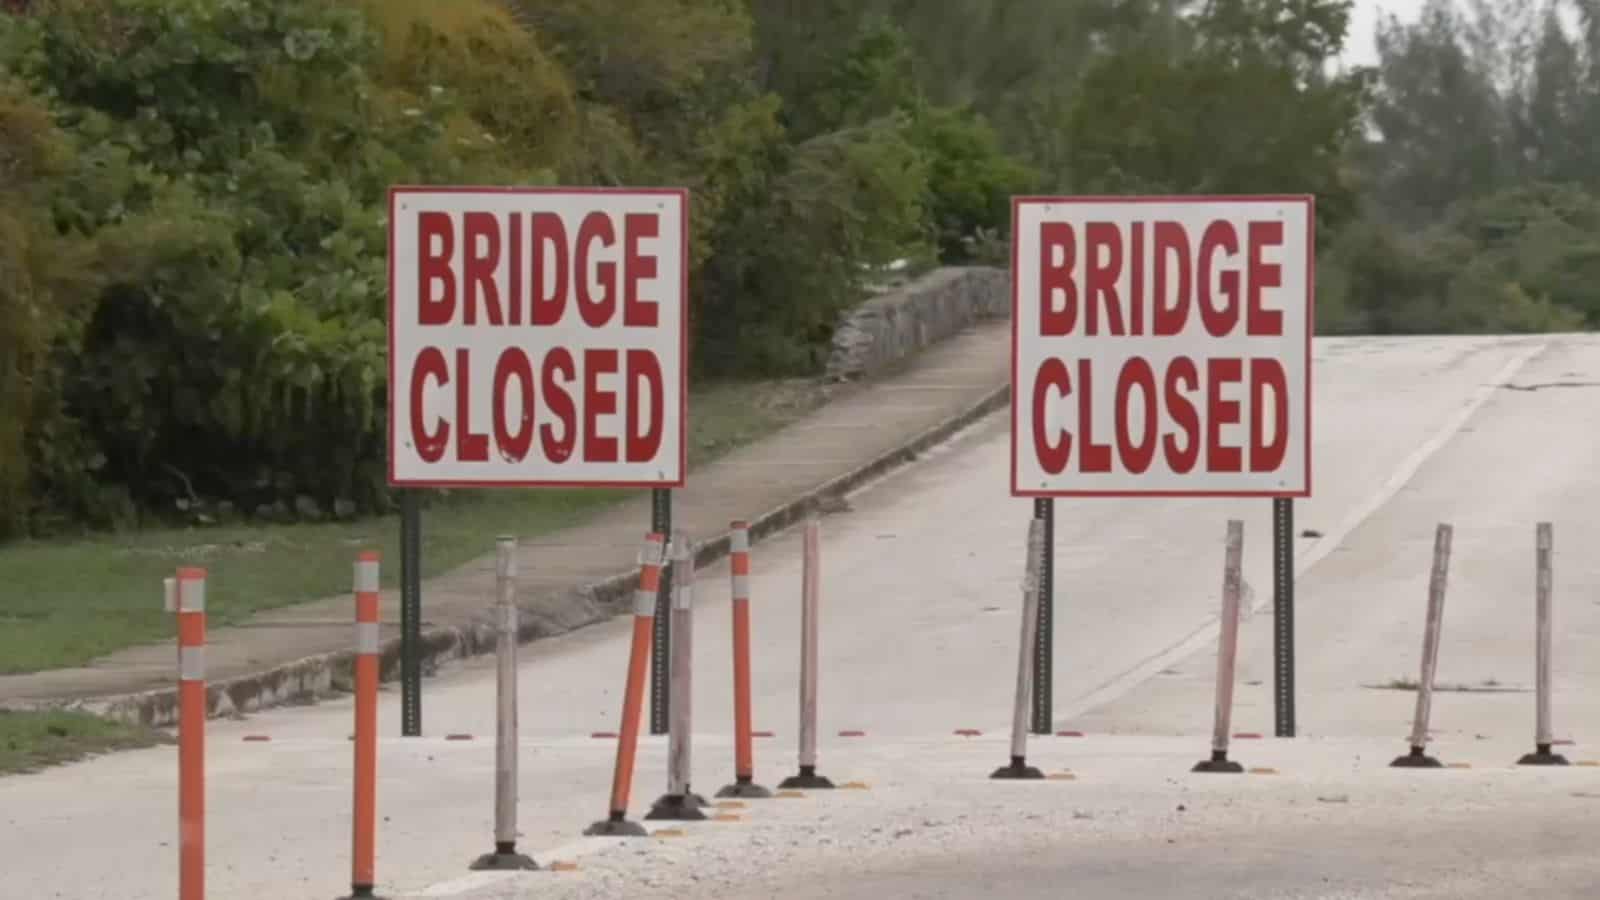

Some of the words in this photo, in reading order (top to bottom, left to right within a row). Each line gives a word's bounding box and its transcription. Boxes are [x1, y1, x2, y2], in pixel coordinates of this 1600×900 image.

[418, 211, 659, 328] BRIDGE
[1039, 220, 1284, 338] BRIDGE
[410, 346, 664, 464] CLOSED
[1032, 356, 1288, 475] CLOSED
